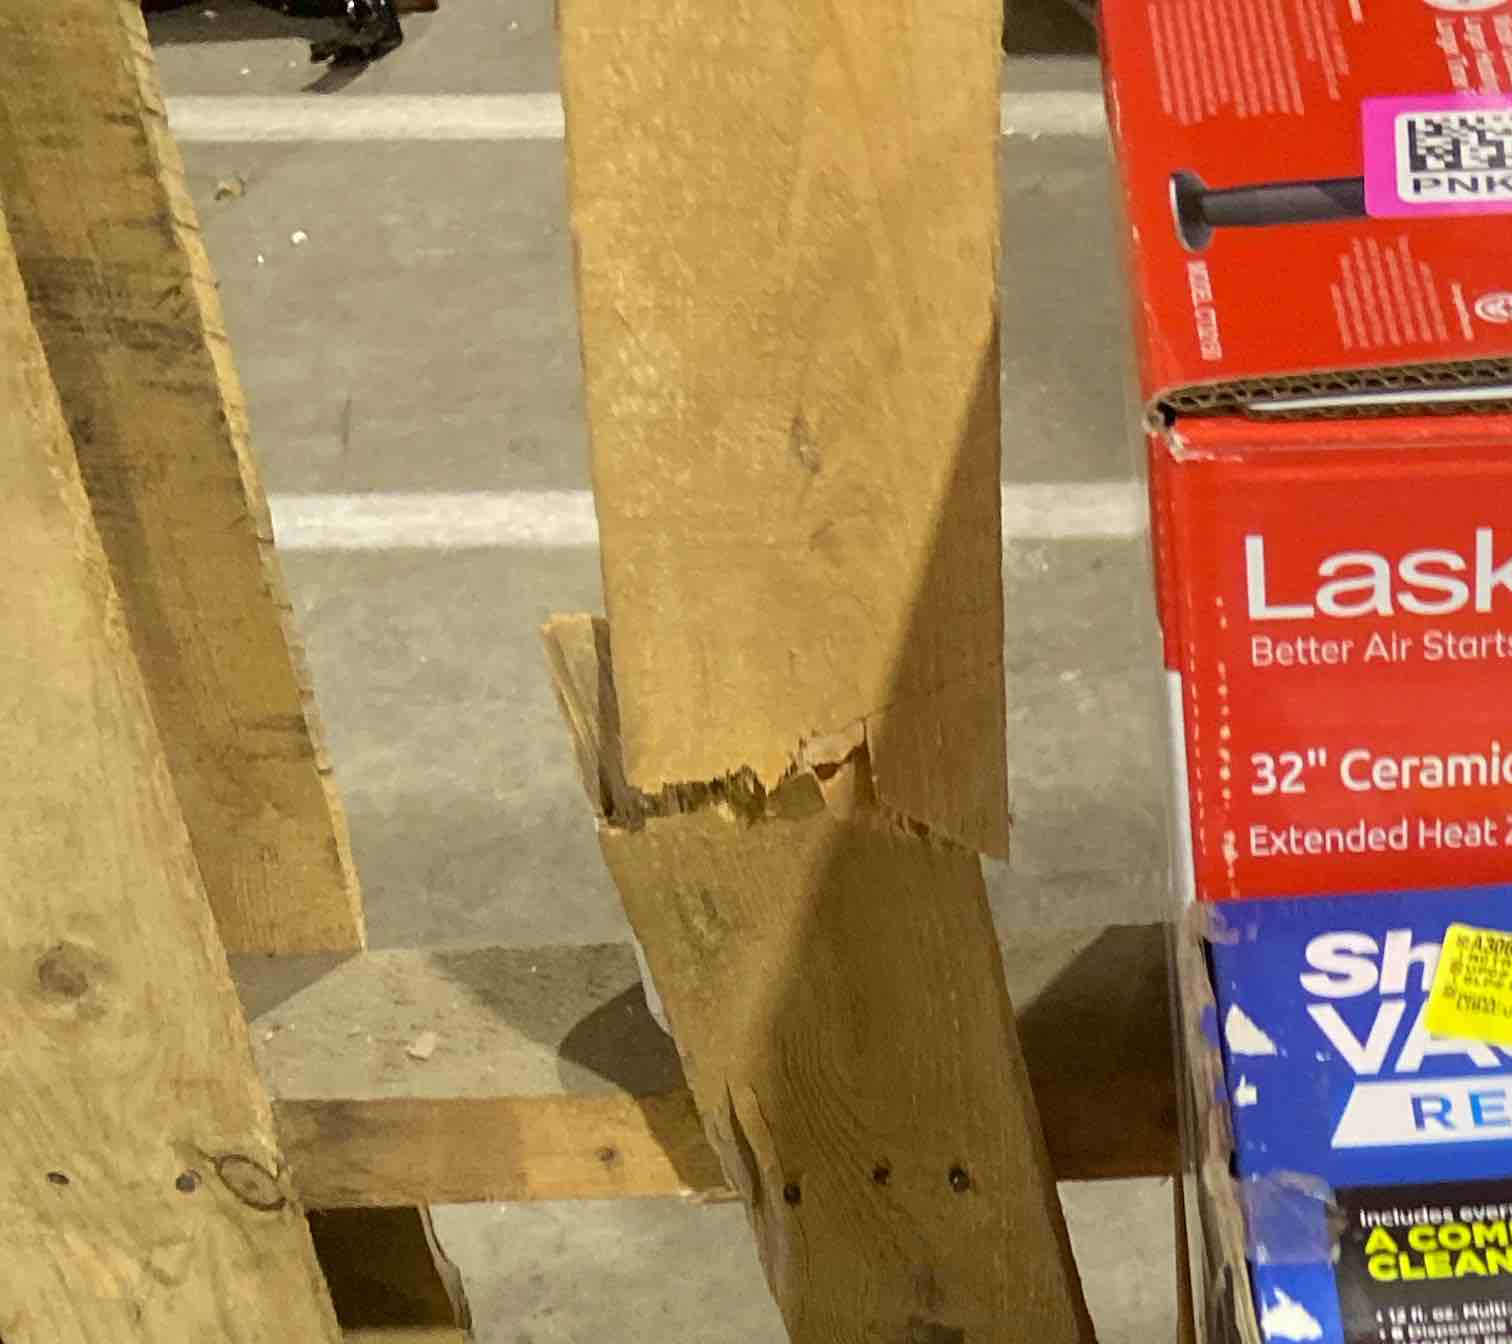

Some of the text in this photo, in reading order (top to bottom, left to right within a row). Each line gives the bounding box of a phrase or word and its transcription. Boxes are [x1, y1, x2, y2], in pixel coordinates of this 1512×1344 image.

[1251, 632, 1354, 667] Better
[1364, 629, 1412, 663] Air
[1251, 750, 1328, 795] 32"
[1249, 820, 1409, 857] Extended
[1419, 818, 1498, 851] Heat
[1365, 1225, 1398, 1255] A
